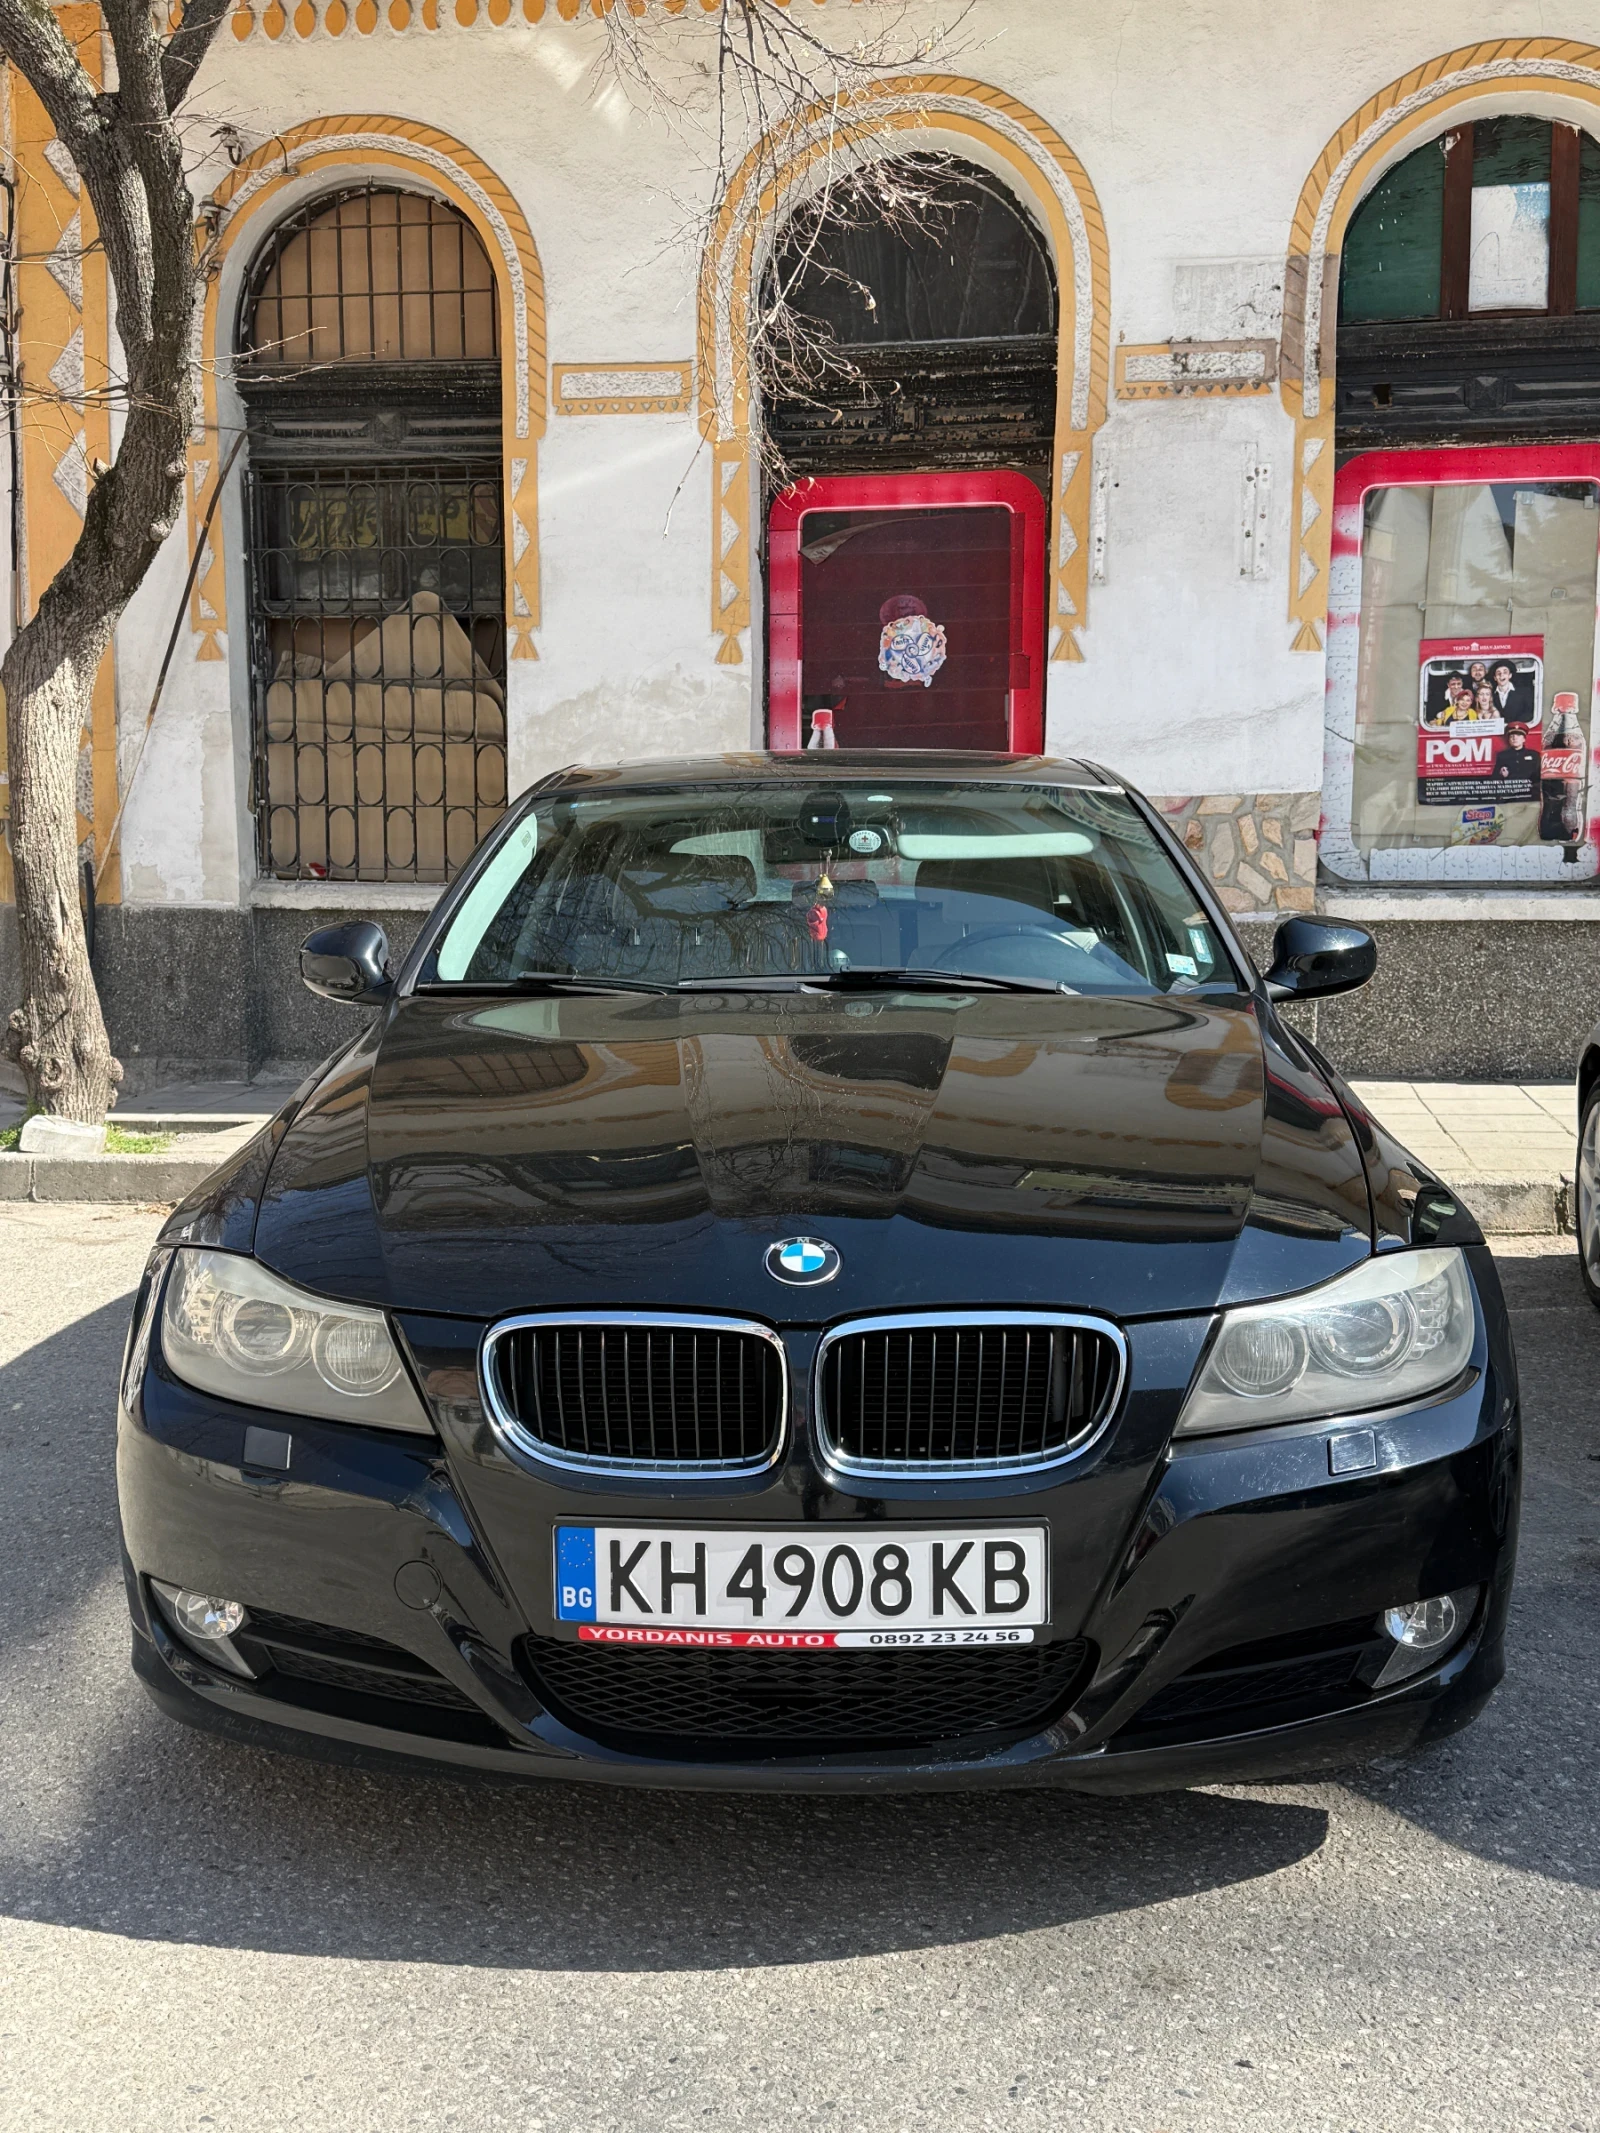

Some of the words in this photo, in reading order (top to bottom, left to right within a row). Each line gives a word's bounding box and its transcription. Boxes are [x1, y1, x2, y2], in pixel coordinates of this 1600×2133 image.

[1541, 752, 1583, 774] Coca-Co
[1466, 809, 1492, 820] Step
[609, 1540, 707, 1616] KH
[726, 1543, 912, 1617] 4908
[932, 1540, 1030, 1616] KB
[563, 1586, 592, 1608] BG
[588, 1627, 733, 1645] YORDANIS
[746, 1634, 825, 1646] AUTO
[869, 1633, 925, 1645] 0892
[931, 1632, 956, 1643] 23
[962, 1632, 989, 1643] 24
[995, 1631, 1020, 1641] 56
